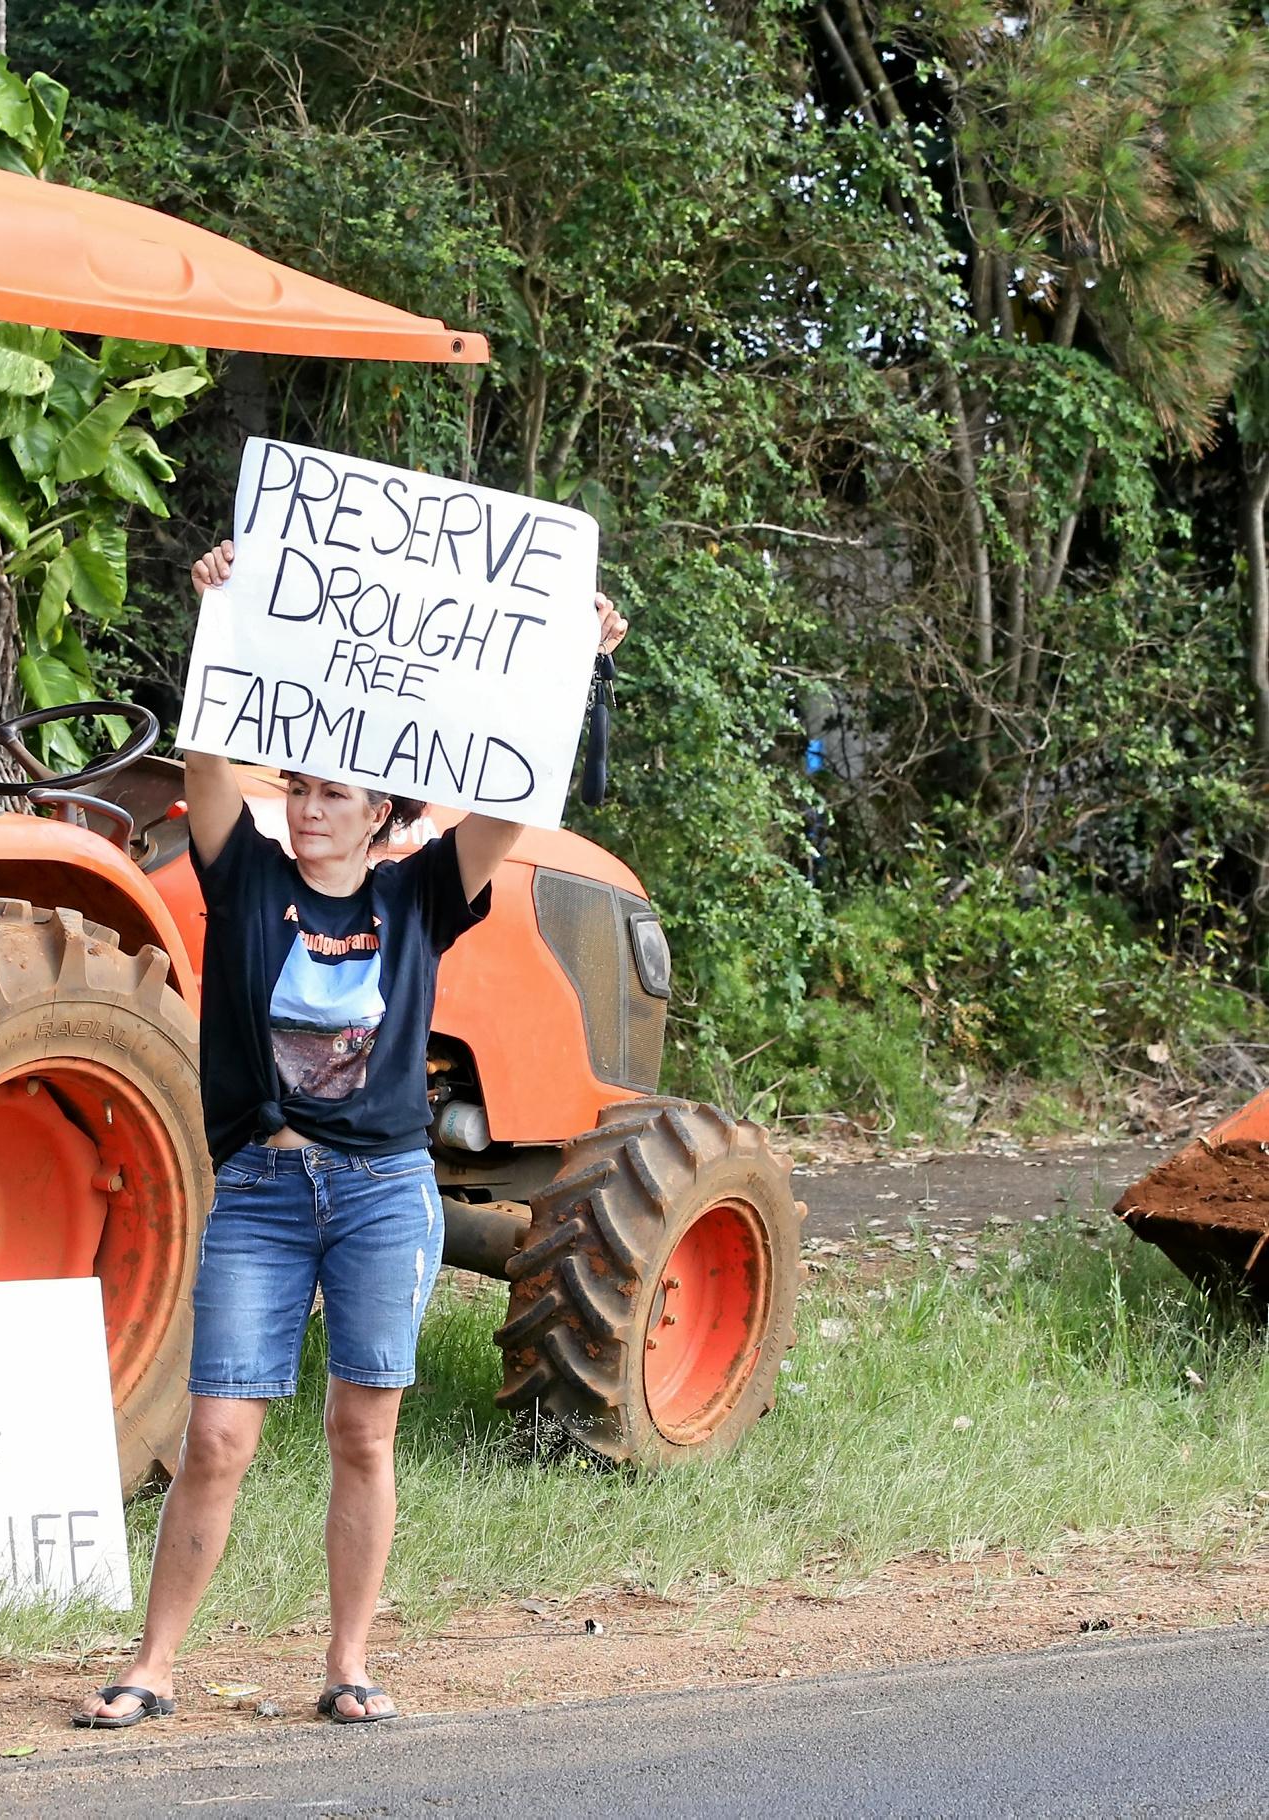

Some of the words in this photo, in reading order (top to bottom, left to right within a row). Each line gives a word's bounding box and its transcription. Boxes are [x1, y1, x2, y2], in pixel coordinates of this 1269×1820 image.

[244, 443, 576, 597] PRESERVE
[268, 548, 546, 674] DROUGHT
[324, 640, 439, 701] FREE
[191, 665, 535, 803] FARMLAND
[35, 1020, 128, 1051] RADIAL
